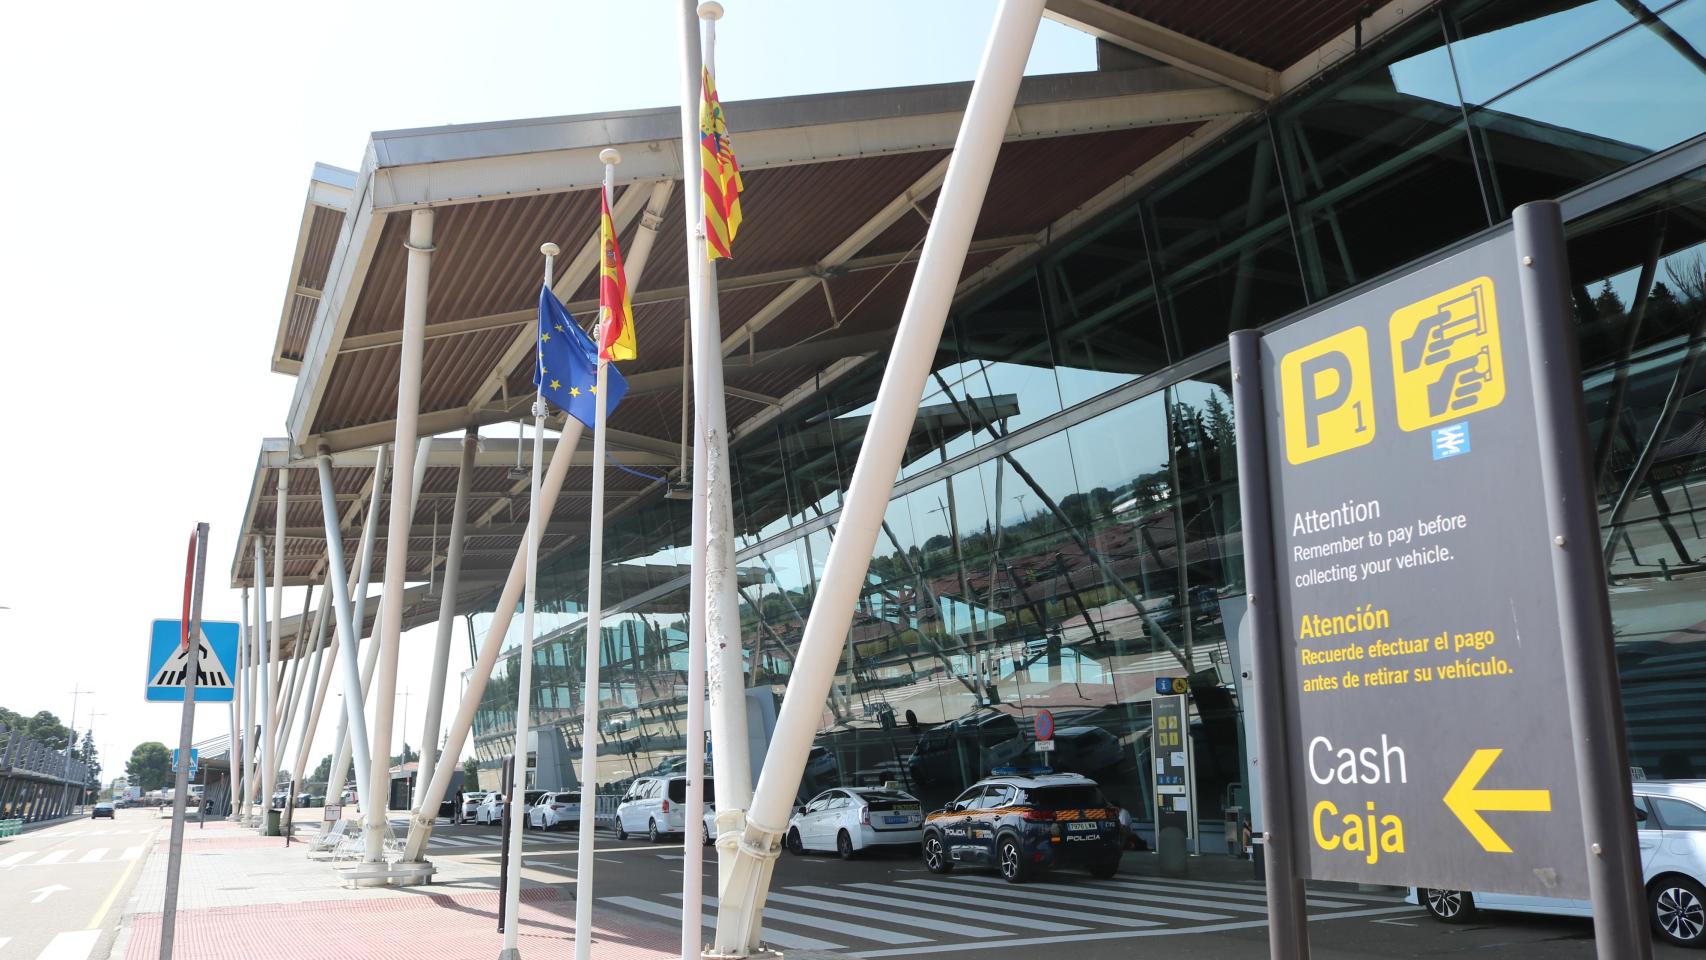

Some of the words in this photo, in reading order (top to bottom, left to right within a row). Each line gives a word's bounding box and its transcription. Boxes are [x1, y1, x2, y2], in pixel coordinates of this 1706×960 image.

[1293, 499, 1381, 536] Attention
[1294, 535, 1364, 562] Remember
[1369, 530, 1383, 547] to
[1388, 524, 1413, 548] pay
[1418, 513, 1467, 537] before
[1295, 562, 1357, 588] collecting
[1361, 555, 1392, 580] your
[1396, 545, 1455, 569] vehicle.
[1300, 604, 1390, 639] Atención
[1301, 643, 1364, 666] Recuerde
[1368, 636, 1429, 658] efectuar
[1434, 632, 1448, 651] el
[1454, 629, 1495, 653] pago
[1303, 673, 1338, 692] antes
[1342, 667, 1360, 688] de
[1364, 663, 1409, 687] retirar
[1414, 666, 1432, 682] su
[1436, 656, 1514, 680] vehículo.
[1308, 733, 1408, 785] Cash
[1312, 800, 1405, 864] Caja
